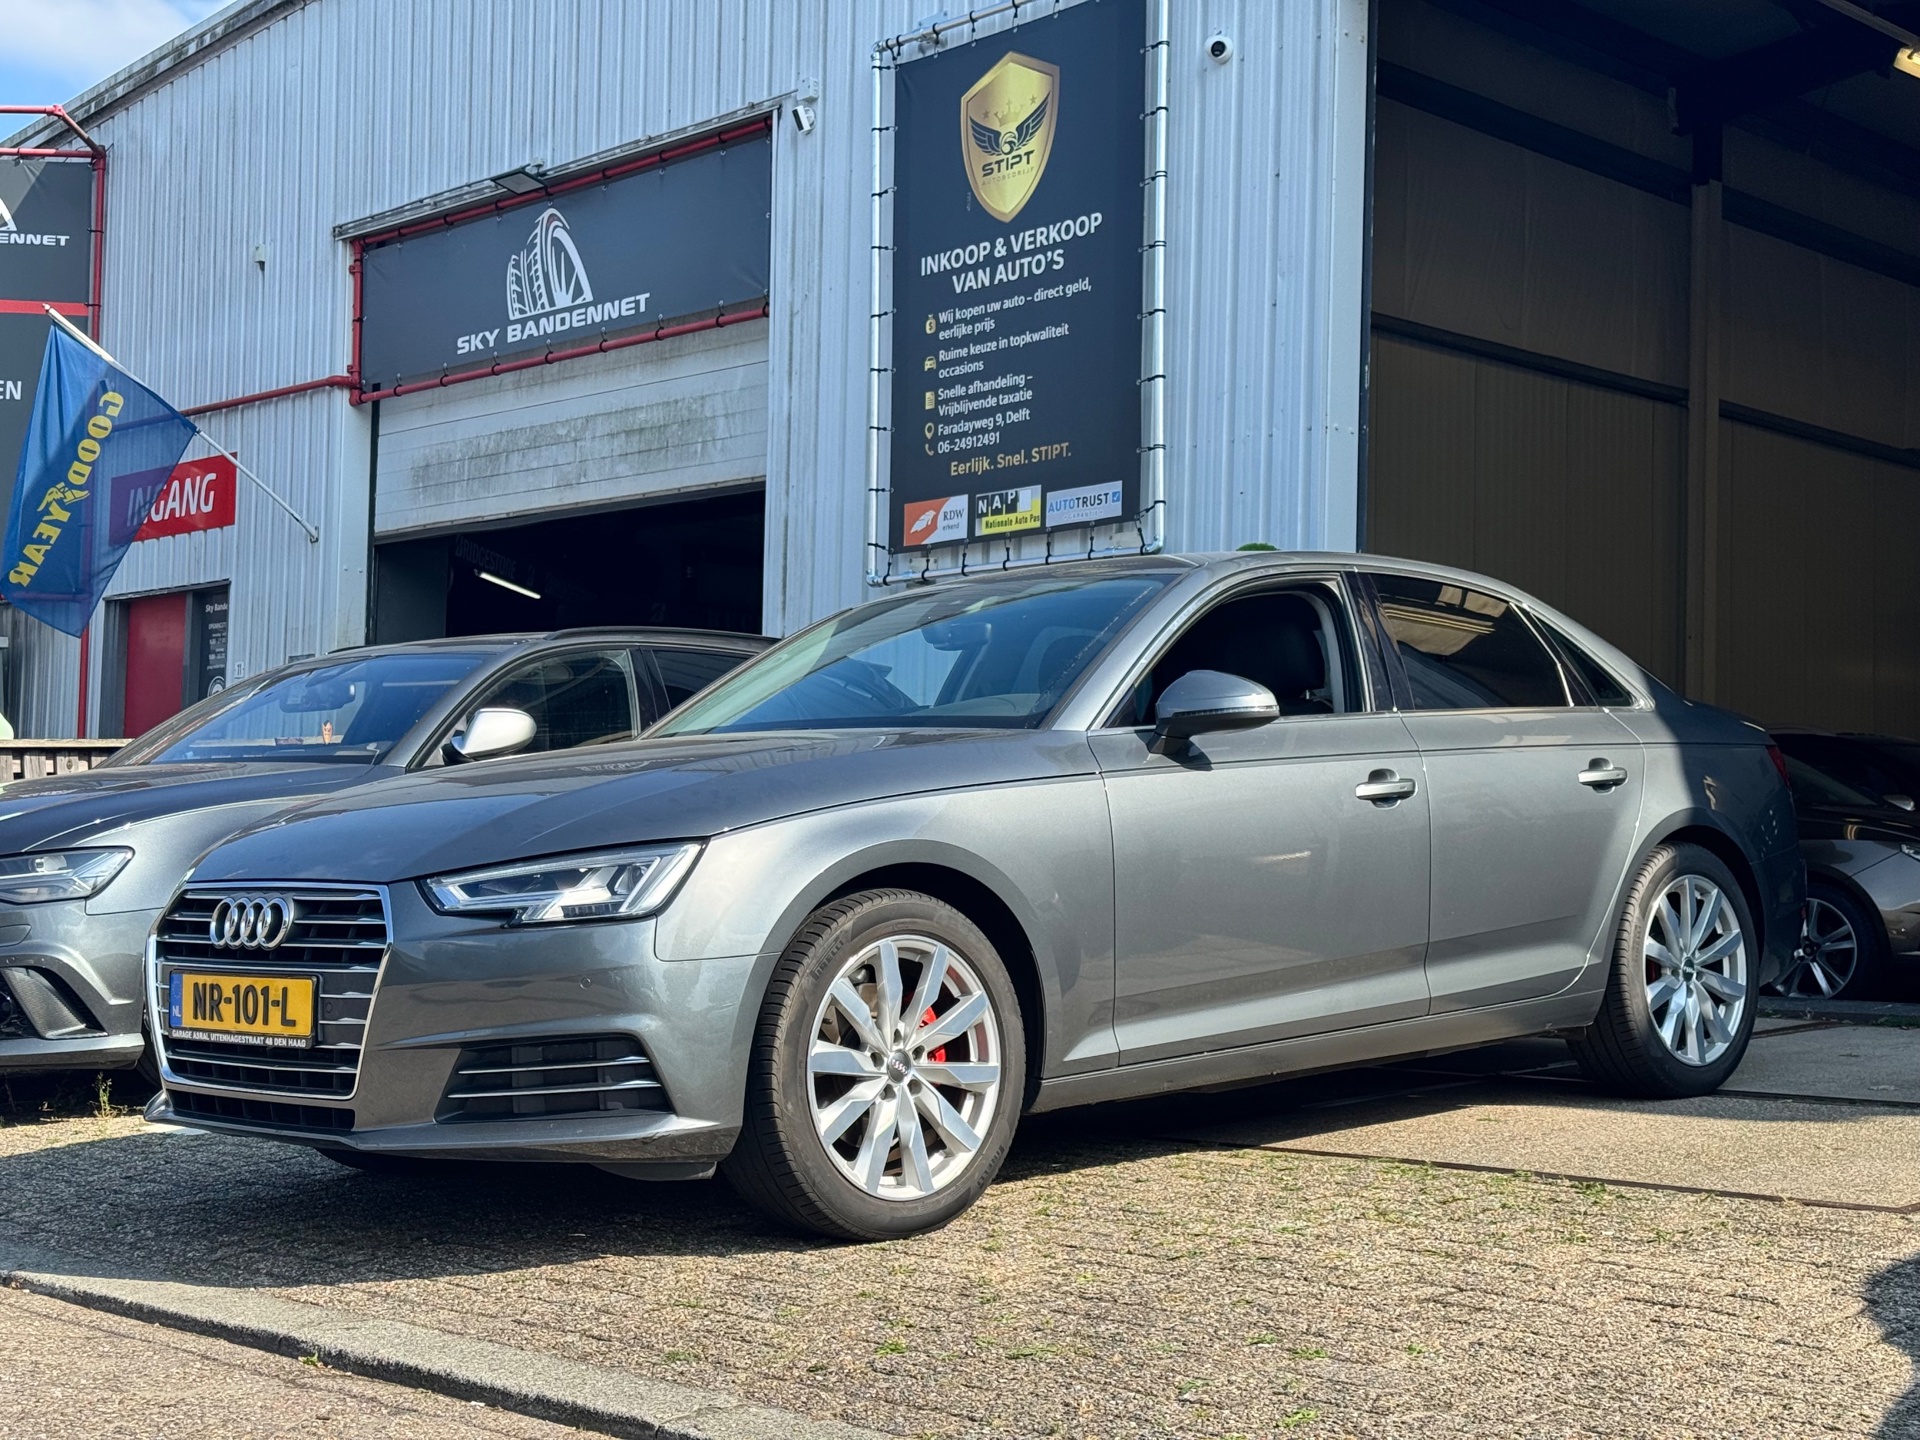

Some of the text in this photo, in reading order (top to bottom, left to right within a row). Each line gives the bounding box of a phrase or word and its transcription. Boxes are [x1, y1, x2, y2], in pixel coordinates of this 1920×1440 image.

[981, 149, 1036, 178] STIPT
[920, 212, 1103, 277] INKOOP & VERKOOP
[952, 268, 990, 294] VAN
[938, 309, 954, 325] Wij
[955, 304, 985, 323] kopen
[987, 302, 1001, 313] uw
[1003, 295, 1025, 309] auto
[1034, 287, 1064, 302] direct
[1065, 277, 1092, 296] geld,
[456, 292, 650, 355] SKY BANDENNET
[938, 317, 996, 341] eerlijke prijs
[938, 323, 1070, 362] Ruime keuze in topkwaliteit
[938, 359, 984, 379] occasions
[938, 383, 967, 400] Snelle
[967, 372, 1025, 394] afhandeling
[938, 388, 1033, 418] Vrijblijvende taxatie
[938, 408, 1031, 438] Faradayweg 9, Delft
[937, 431, 1000, 454] 06-24912491
[950, 442, 1072, 477] Eerlijk. Snel. STIPT.
[126, 472, 217, 527] INGANG
[1048, 492, 1110, 514] AUTOTRUST
[943, 508, 965, 522] RDW
[984, 511, 1040, 530] Nationale Auto Pas
[172, 1004, 182, 1017] NL
[192, 981, 297, 1028] NR-101-L
[171, 1028, 193, 1039] GARAGE
[210, 1032, 265, 1045] UITENHAGESTRAAT
[274, 1037, 287, 1047] DEN
[288, 1038, 306, 1048] HAAG
